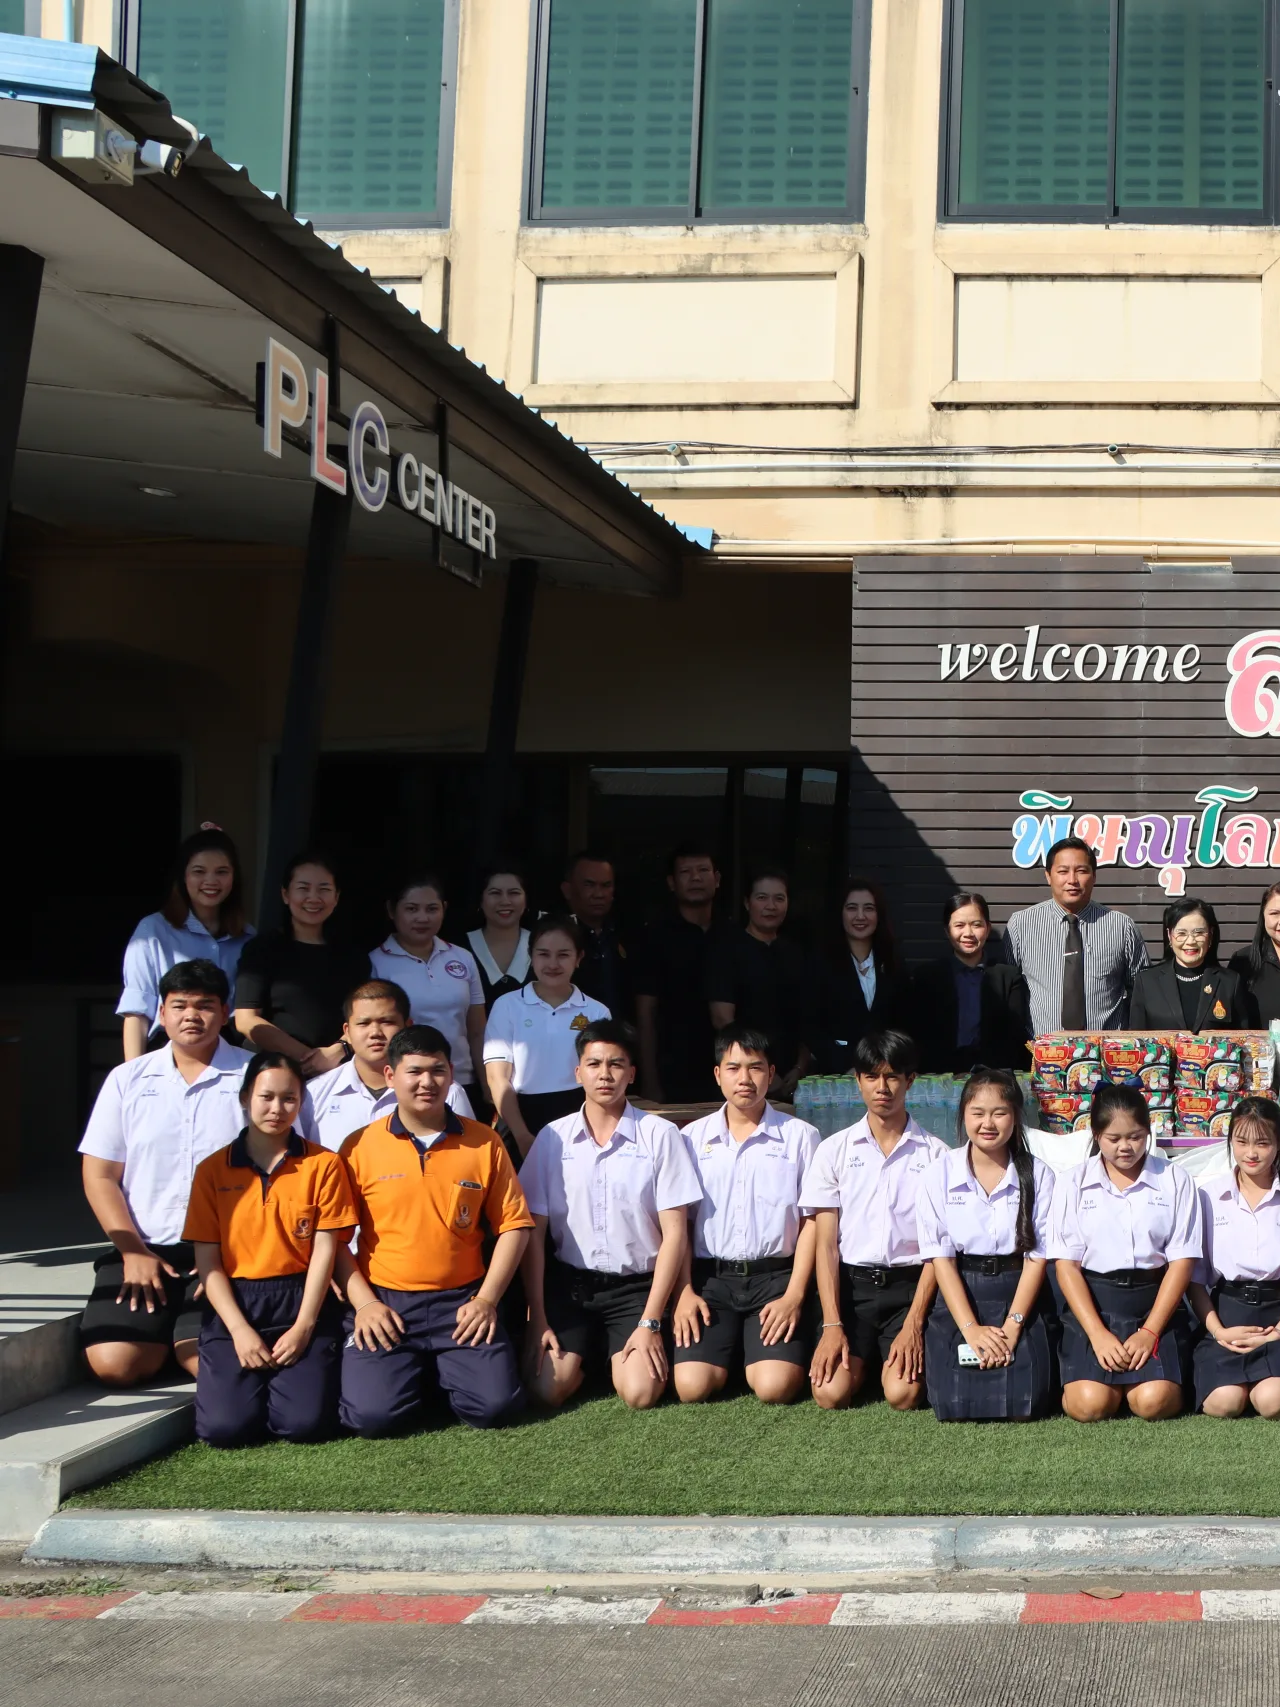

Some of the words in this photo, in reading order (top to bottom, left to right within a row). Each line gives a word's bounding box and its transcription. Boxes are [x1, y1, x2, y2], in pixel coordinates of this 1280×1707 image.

[263, 336, 390, 513] PLC
[397, 451, 498, 561] CENTER
[937, 623, 1202, 683] welcome
